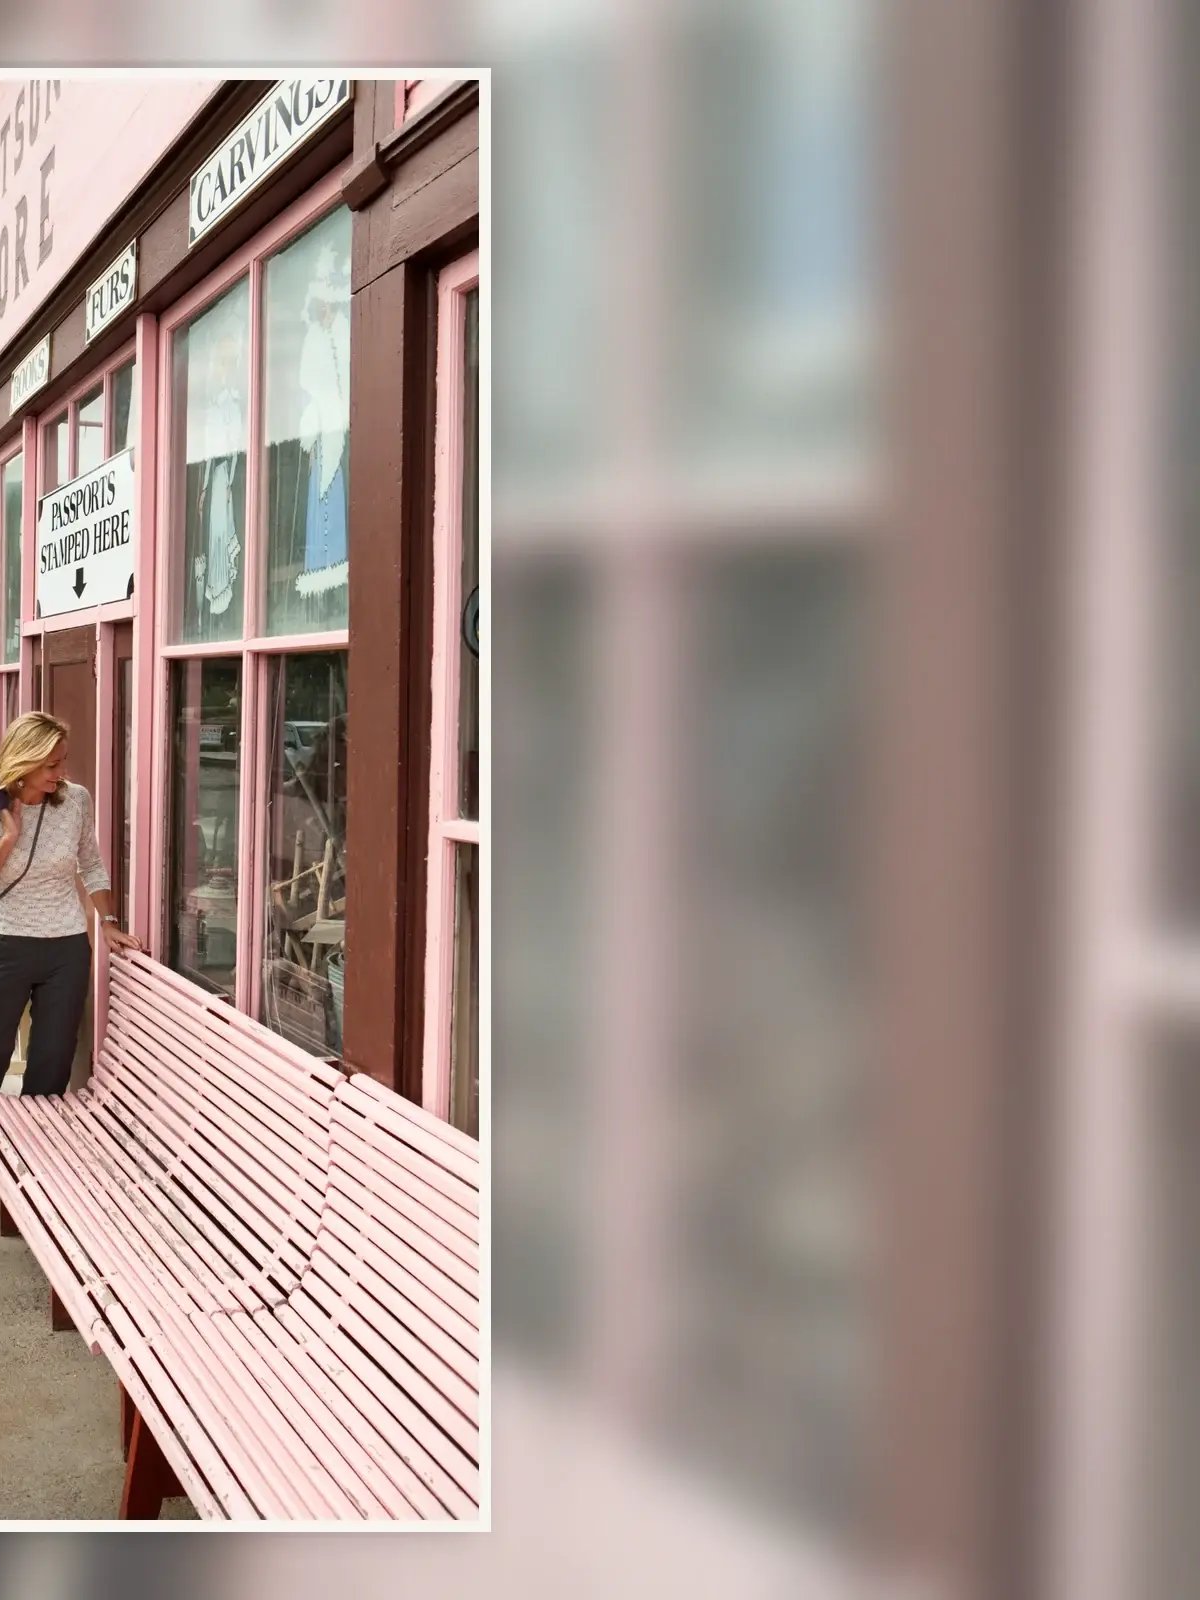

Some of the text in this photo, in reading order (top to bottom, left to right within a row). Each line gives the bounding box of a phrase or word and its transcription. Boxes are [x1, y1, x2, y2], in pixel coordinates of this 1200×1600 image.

[91, 258, 129, 329] FURS
[51, 470, 115, 531] PASSPORTS
[40, 509, 129, 574] STAMPED HERE
